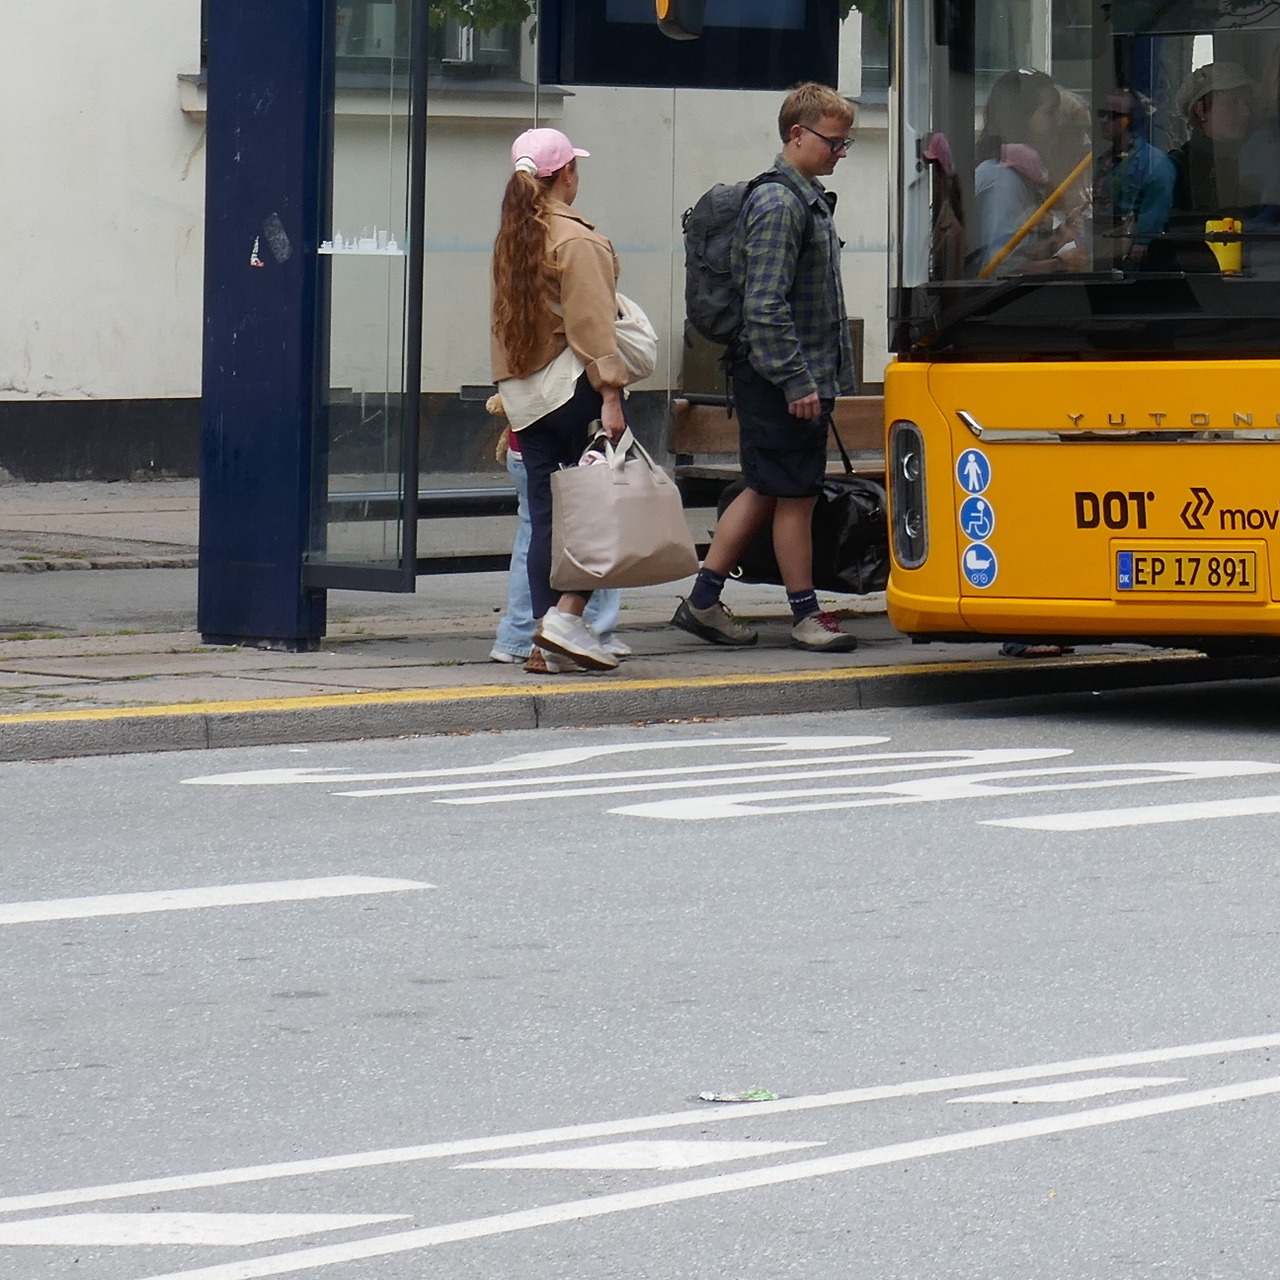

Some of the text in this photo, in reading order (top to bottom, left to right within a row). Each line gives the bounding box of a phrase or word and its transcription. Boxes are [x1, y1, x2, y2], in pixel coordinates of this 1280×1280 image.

[1074, 490, 1155, 530] DOT
[1119, 574, 1130, 583] DK
[1135, 557, 1250, 587] EP 17 891
